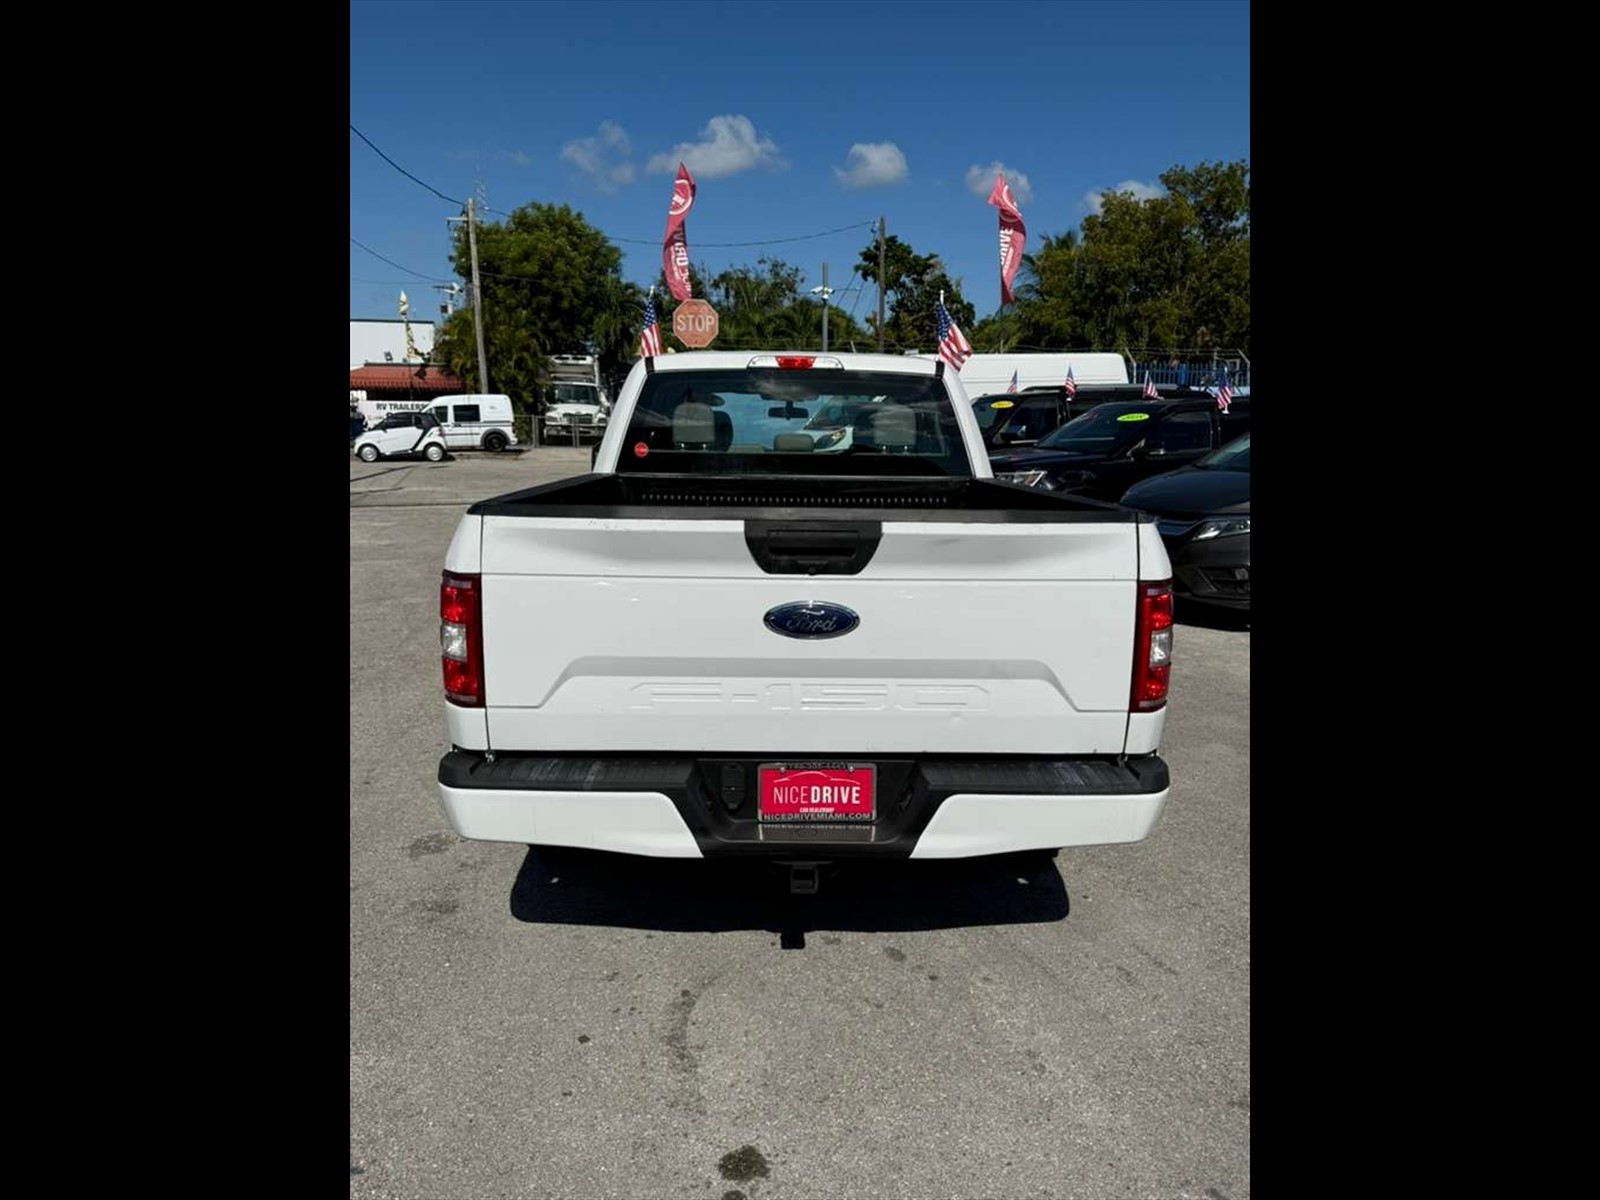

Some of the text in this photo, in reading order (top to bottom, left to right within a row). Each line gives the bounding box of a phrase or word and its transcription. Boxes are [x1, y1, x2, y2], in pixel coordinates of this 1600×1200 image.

[677, 315, 715, 333] STOP
[376, 403, 387, 411] RV
[785, 610, 837, 632] Ford
[628, 682, 990, 712] F-150
[763, 812, 871, 821] NICEDRIVEMIAMI.COM
